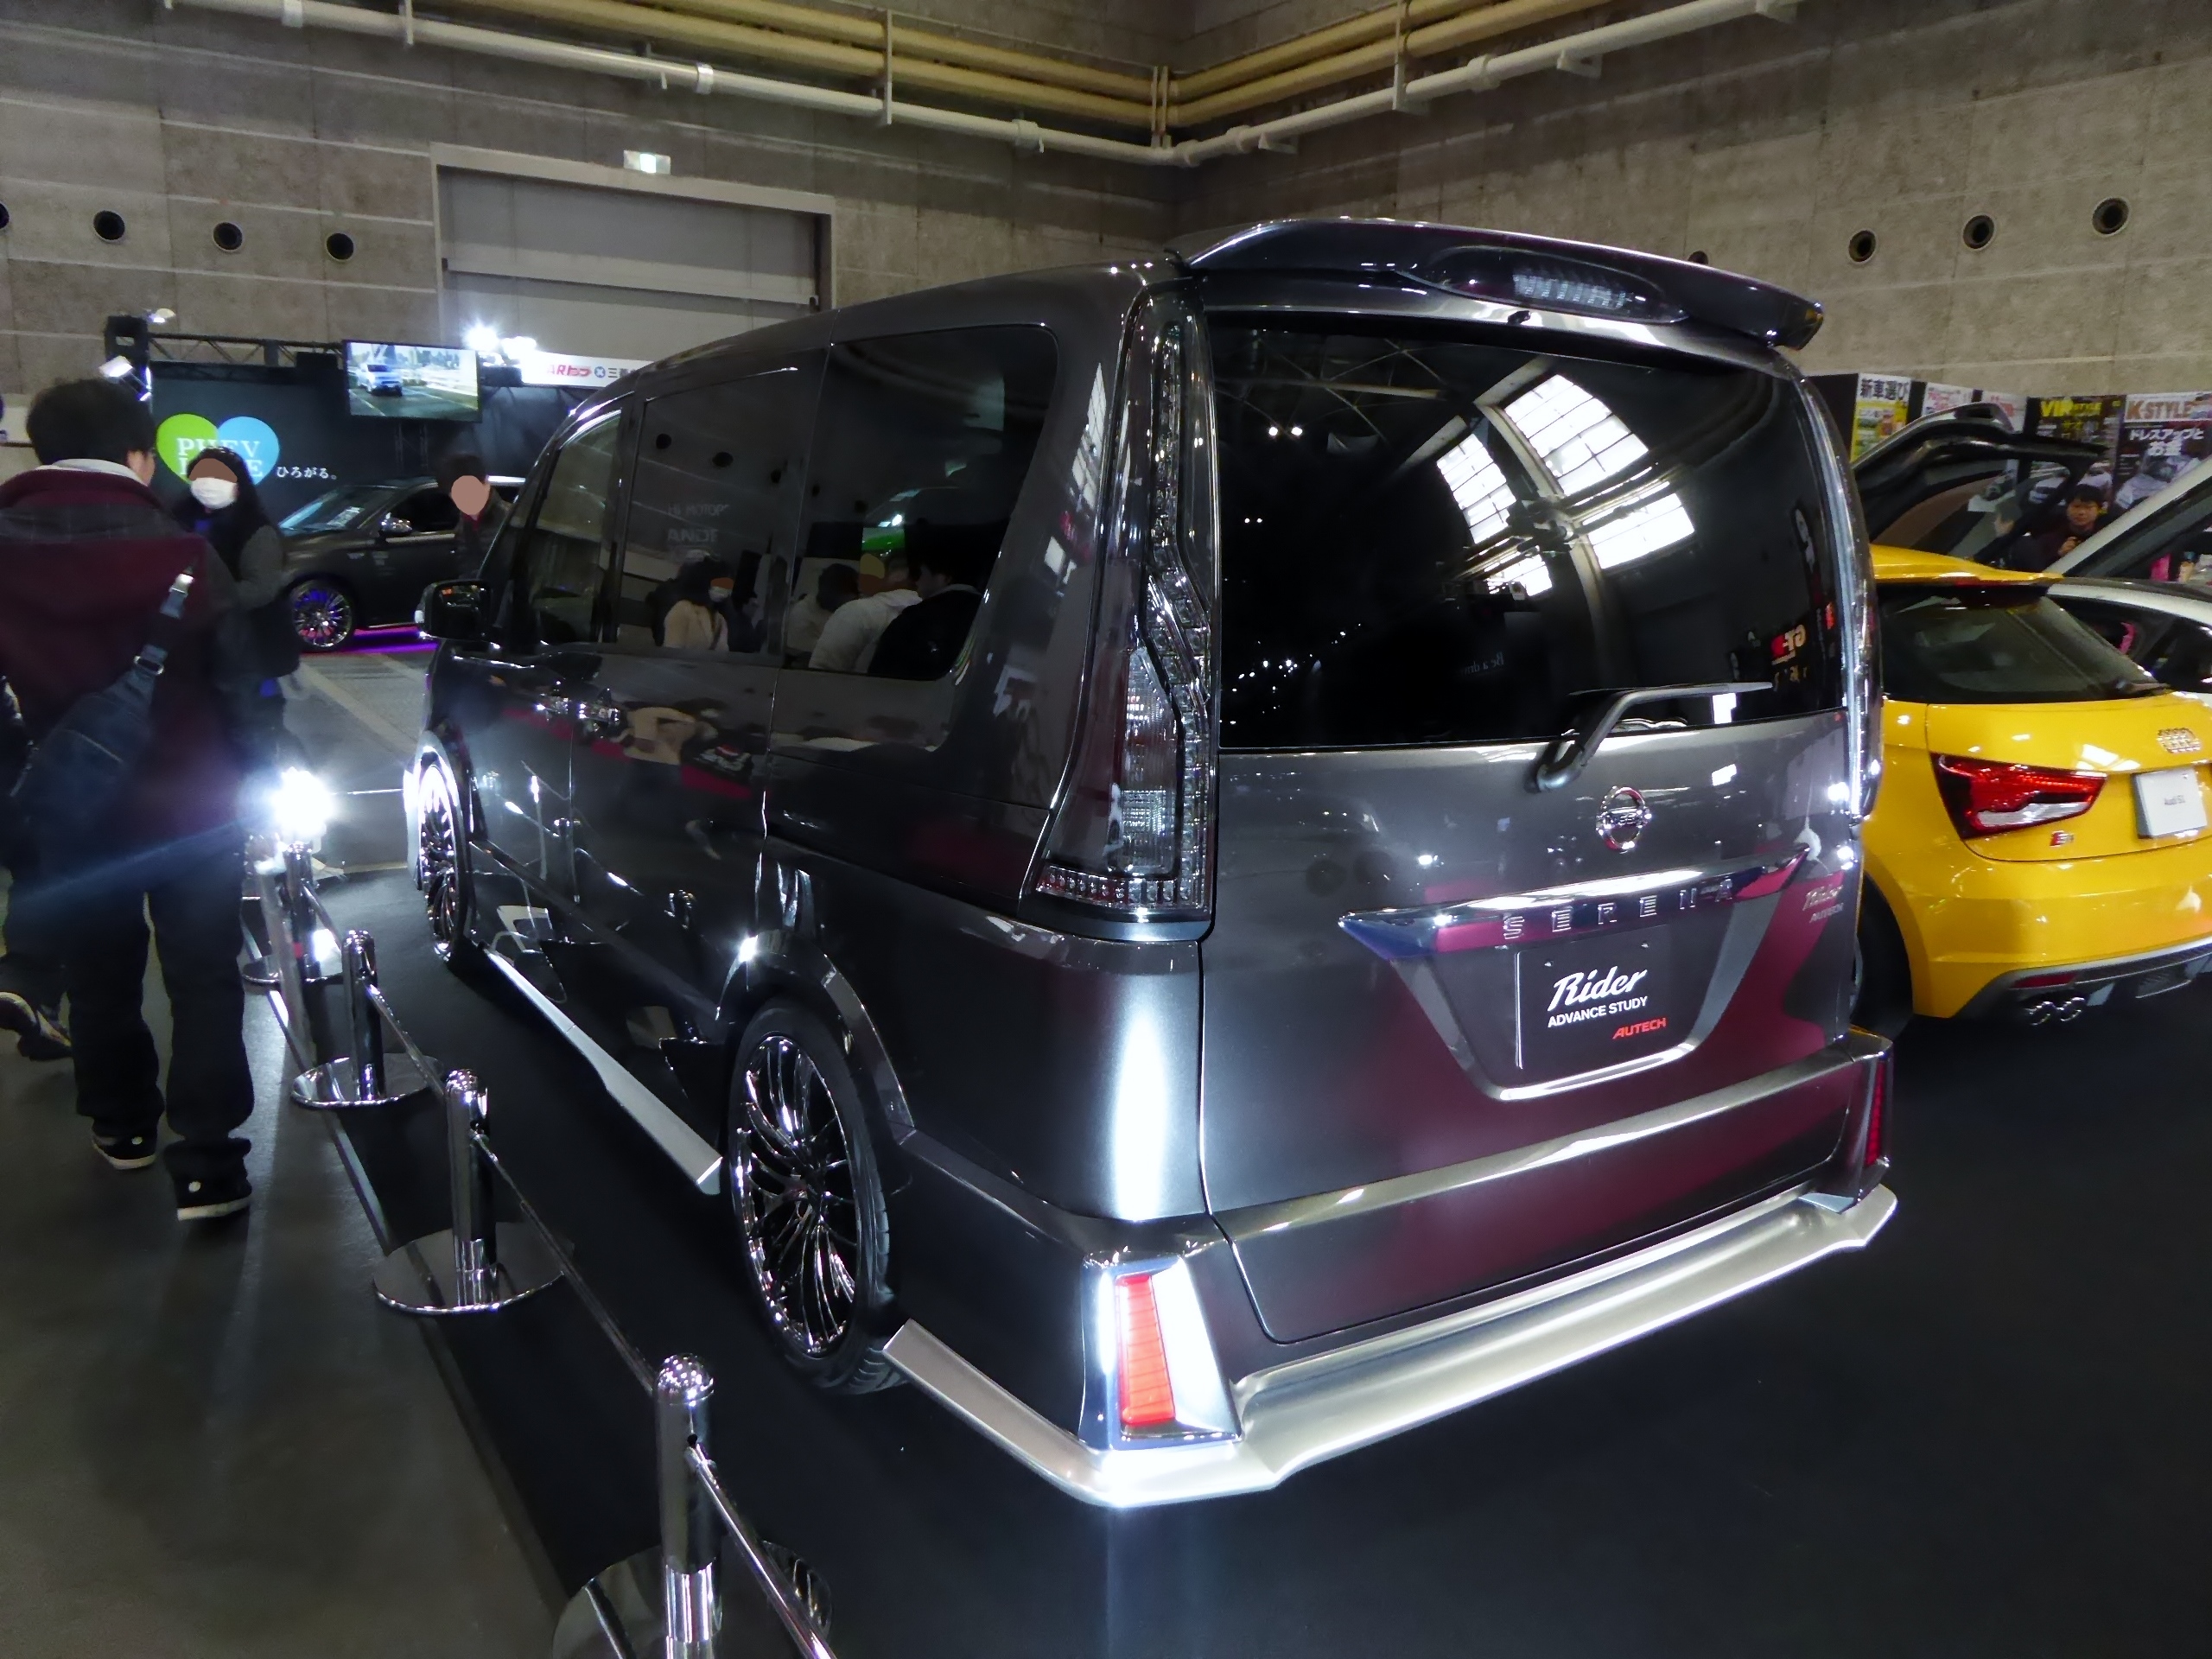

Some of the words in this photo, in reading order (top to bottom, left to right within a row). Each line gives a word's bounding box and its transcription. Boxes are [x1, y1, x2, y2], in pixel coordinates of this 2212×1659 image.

[276, 466, 337, 480] ひろがる。
[1548, 965, 1648, 1012] Rider
[1548, 1005, 1607, 1028] ADVANCE
[1609, 995, 1648, 1014] STUDY
[1612, 1017, 1667, 1039] AUTECH
